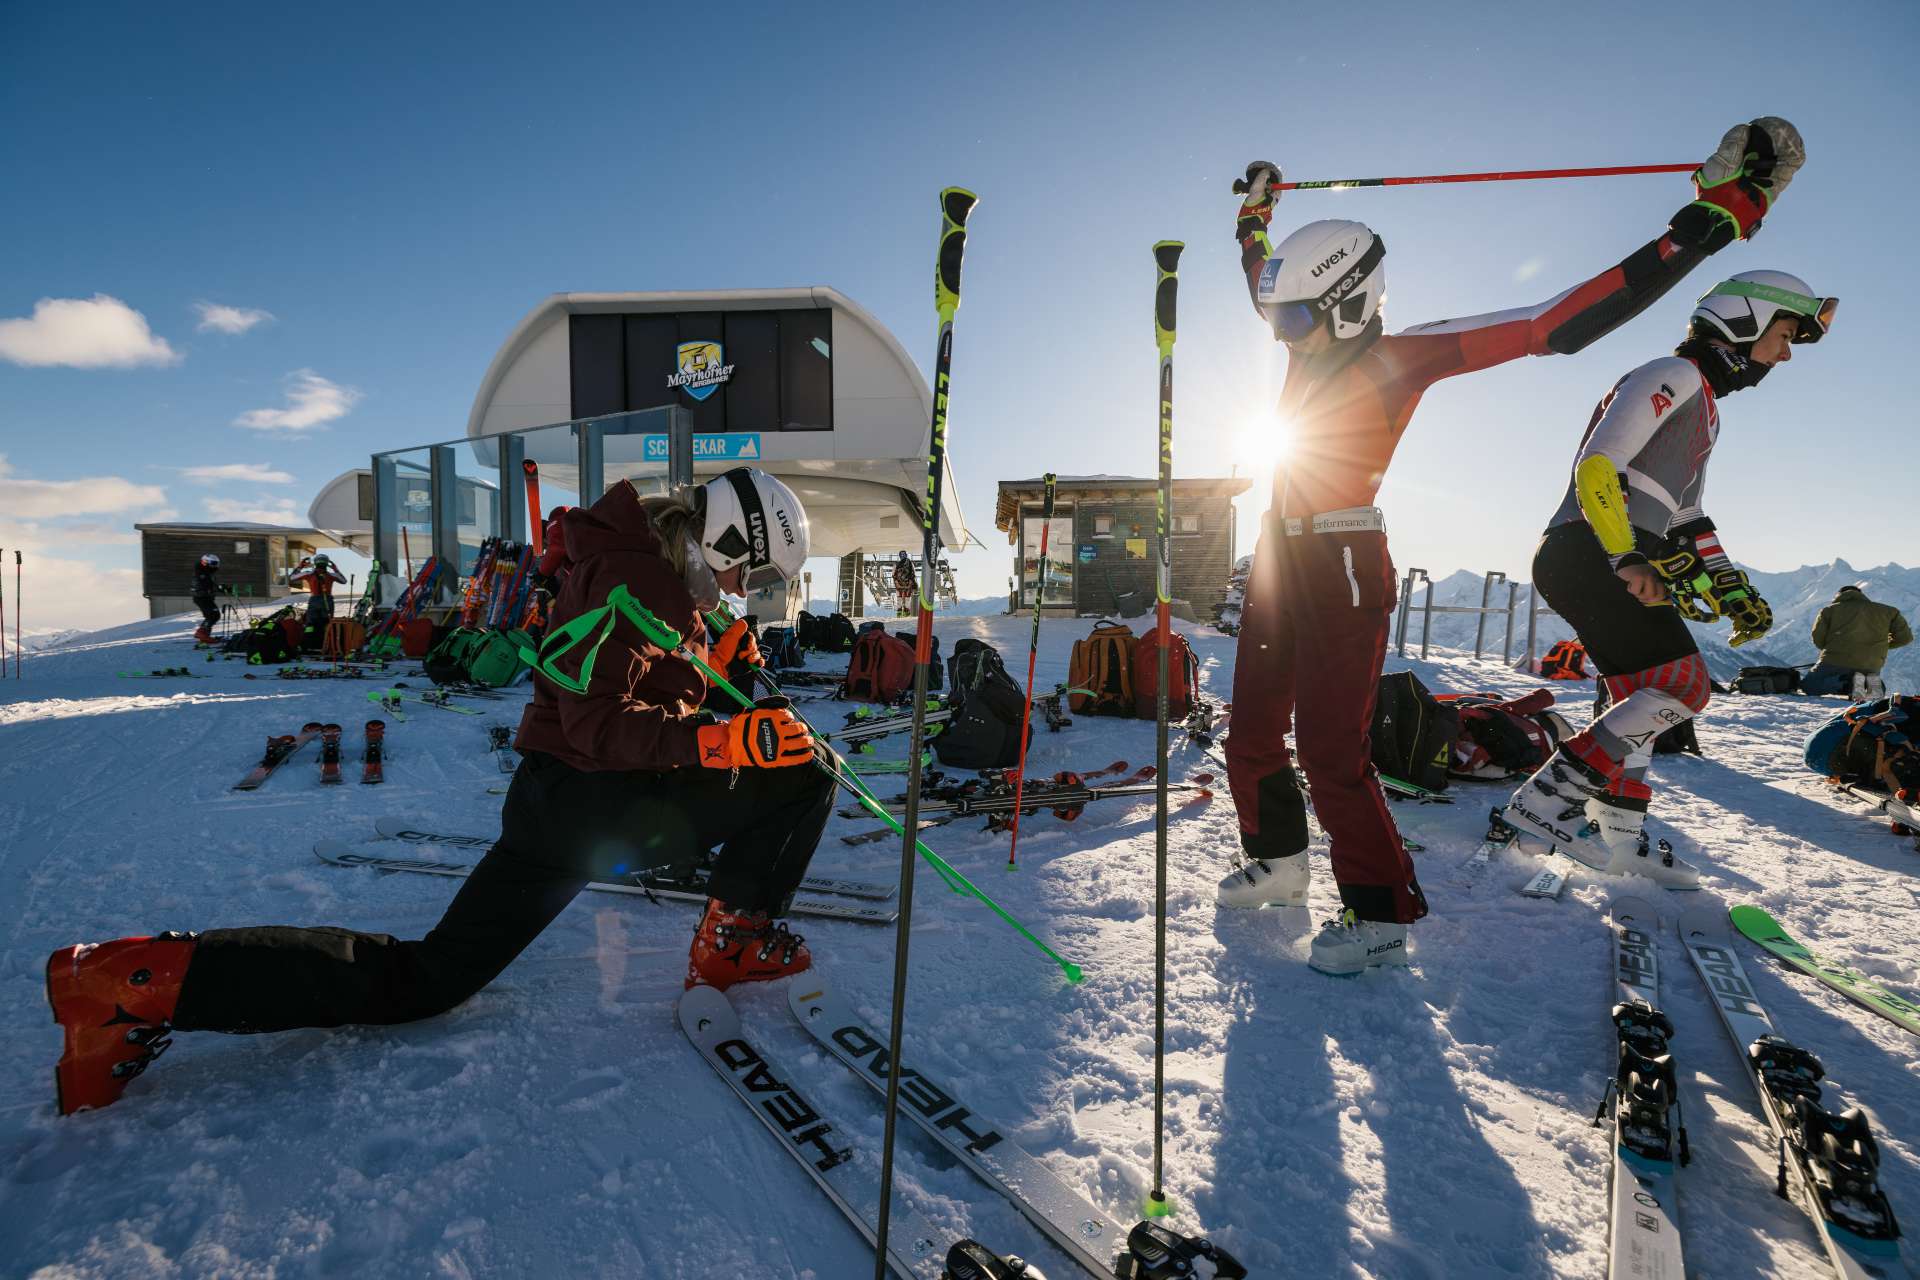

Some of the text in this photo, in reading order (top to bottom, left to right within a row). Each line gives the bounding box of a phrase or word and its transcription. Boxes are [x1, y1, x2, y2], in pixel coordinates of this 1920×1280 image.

[1311, 247, 1348, 279] uvex
[1317, 266, 1365, 311] uvex
[667, 364, 735, 388] Mayrhofner
[934, 372, 950, 447] LEKI
[1650, 383, 1676, 418] A1
[648, 438, 725, 456] SCEKAR
[1162, 400, 1172, 464] LEKI
[1595, 491, 1608, 509] LEKI
[750, 511, 766, 562] uvex
[775, 509, 795, 547] uvex
[1312, 518, 1368, 530] erformance
[762, 721, 773, 759] reusch
[1511, 803, 1573, 843] HEAD
[1609, 825, 1640, 835] HEAD
[1367, 940, 1402, 956] HEAD
[1619, 930, 1655, 991] HEAD
[1695, 946, 1766, 1018] HEAD
[714, 1039, 851, 1173] HEAD
[832, 1025, 1003, 1155] HEAD
